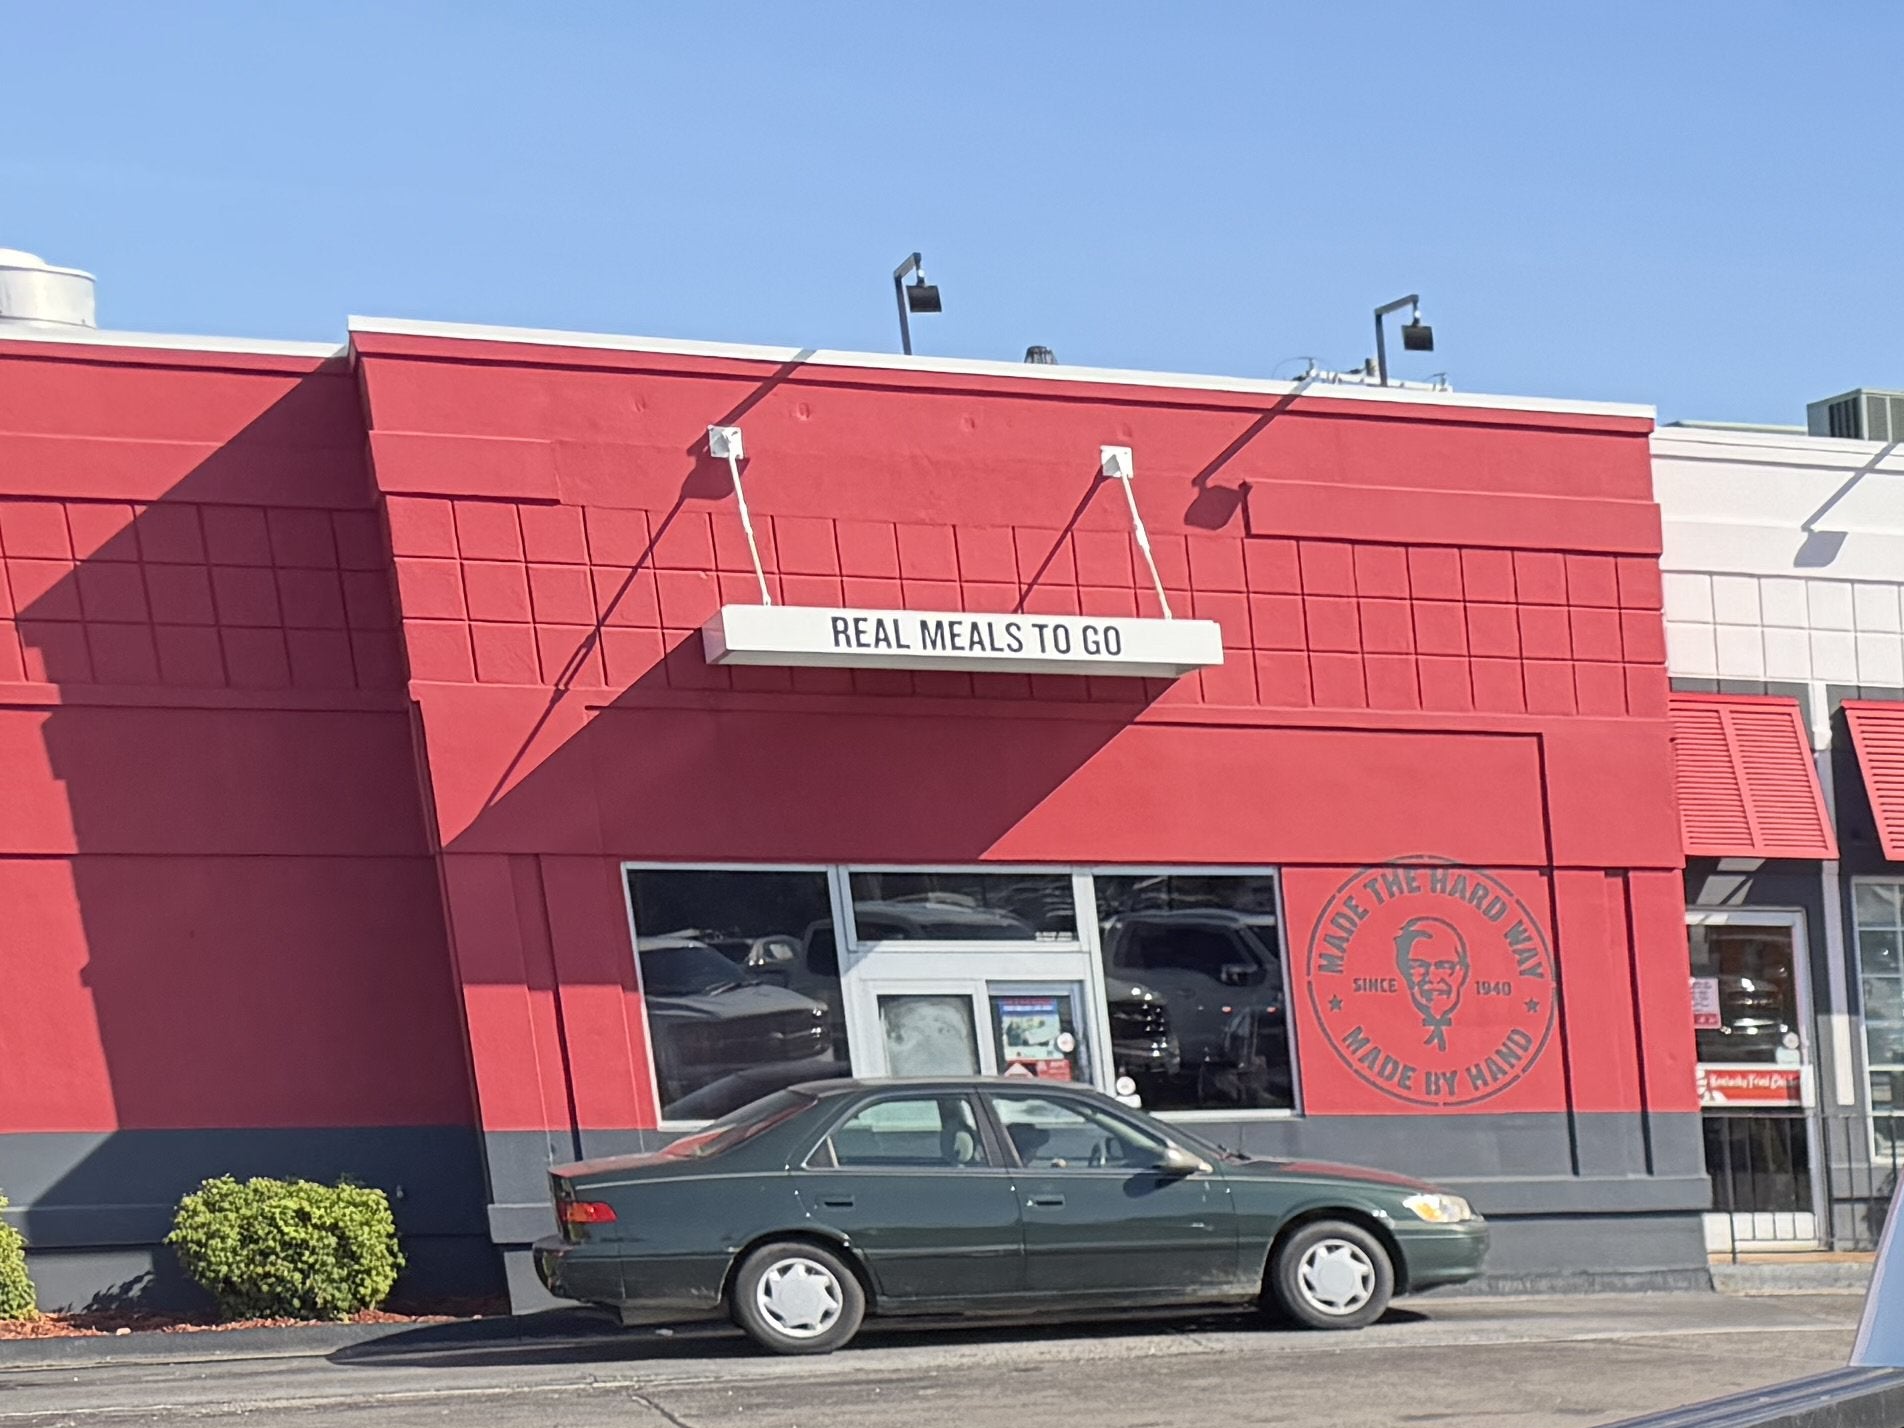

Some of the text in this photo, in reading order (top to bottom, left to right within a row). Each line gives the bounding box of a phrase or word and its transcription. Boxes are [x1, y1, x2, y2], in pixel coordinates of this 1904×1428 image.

[831, 616, 1122, 656] REAL MEALS TO GO
[1317, 866, 1545, 980] MADE THE HARD WAY
[1353, 977, 1512, 996] SINCE 1940
[1342, 1026, 1534, 1095] MADE BY HAND
